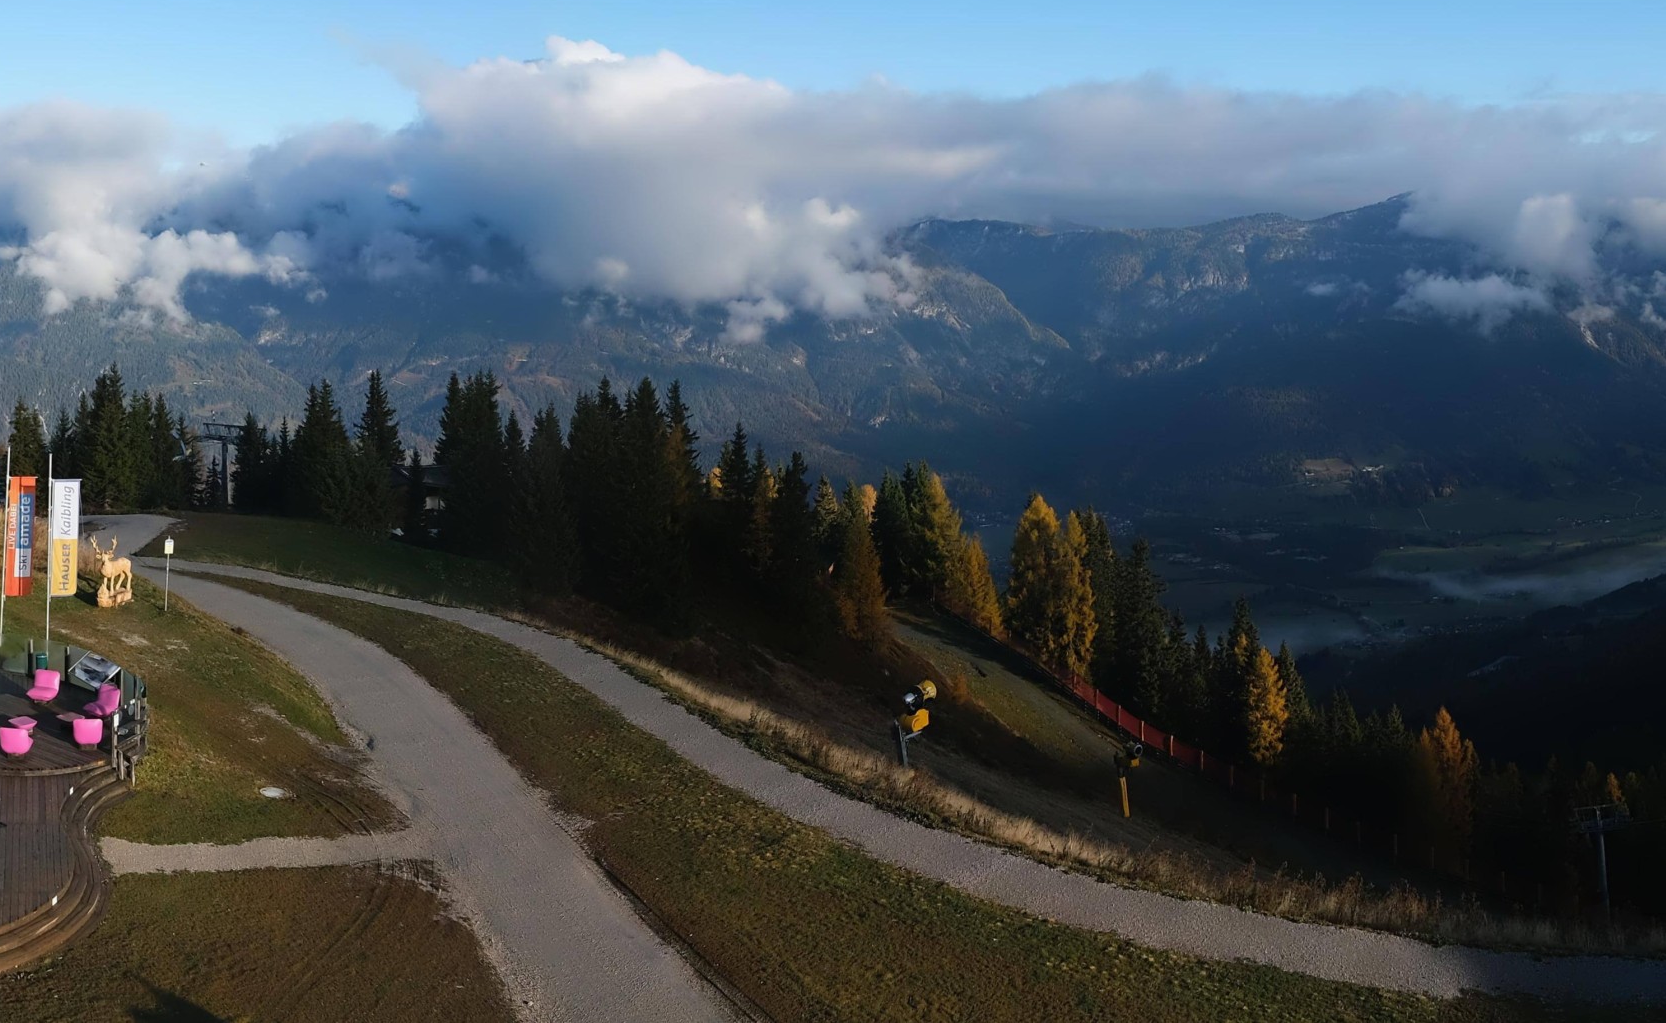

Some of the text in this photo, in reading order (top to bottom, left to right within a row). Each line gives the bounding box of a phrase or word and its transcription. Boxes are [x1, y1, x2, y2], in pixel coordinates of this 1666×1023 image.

[8, 527, 16, 550] LIVE
[58, 485, 75, 591] HAUSER Kaibling
[18, 554, 28, 571] Ski
